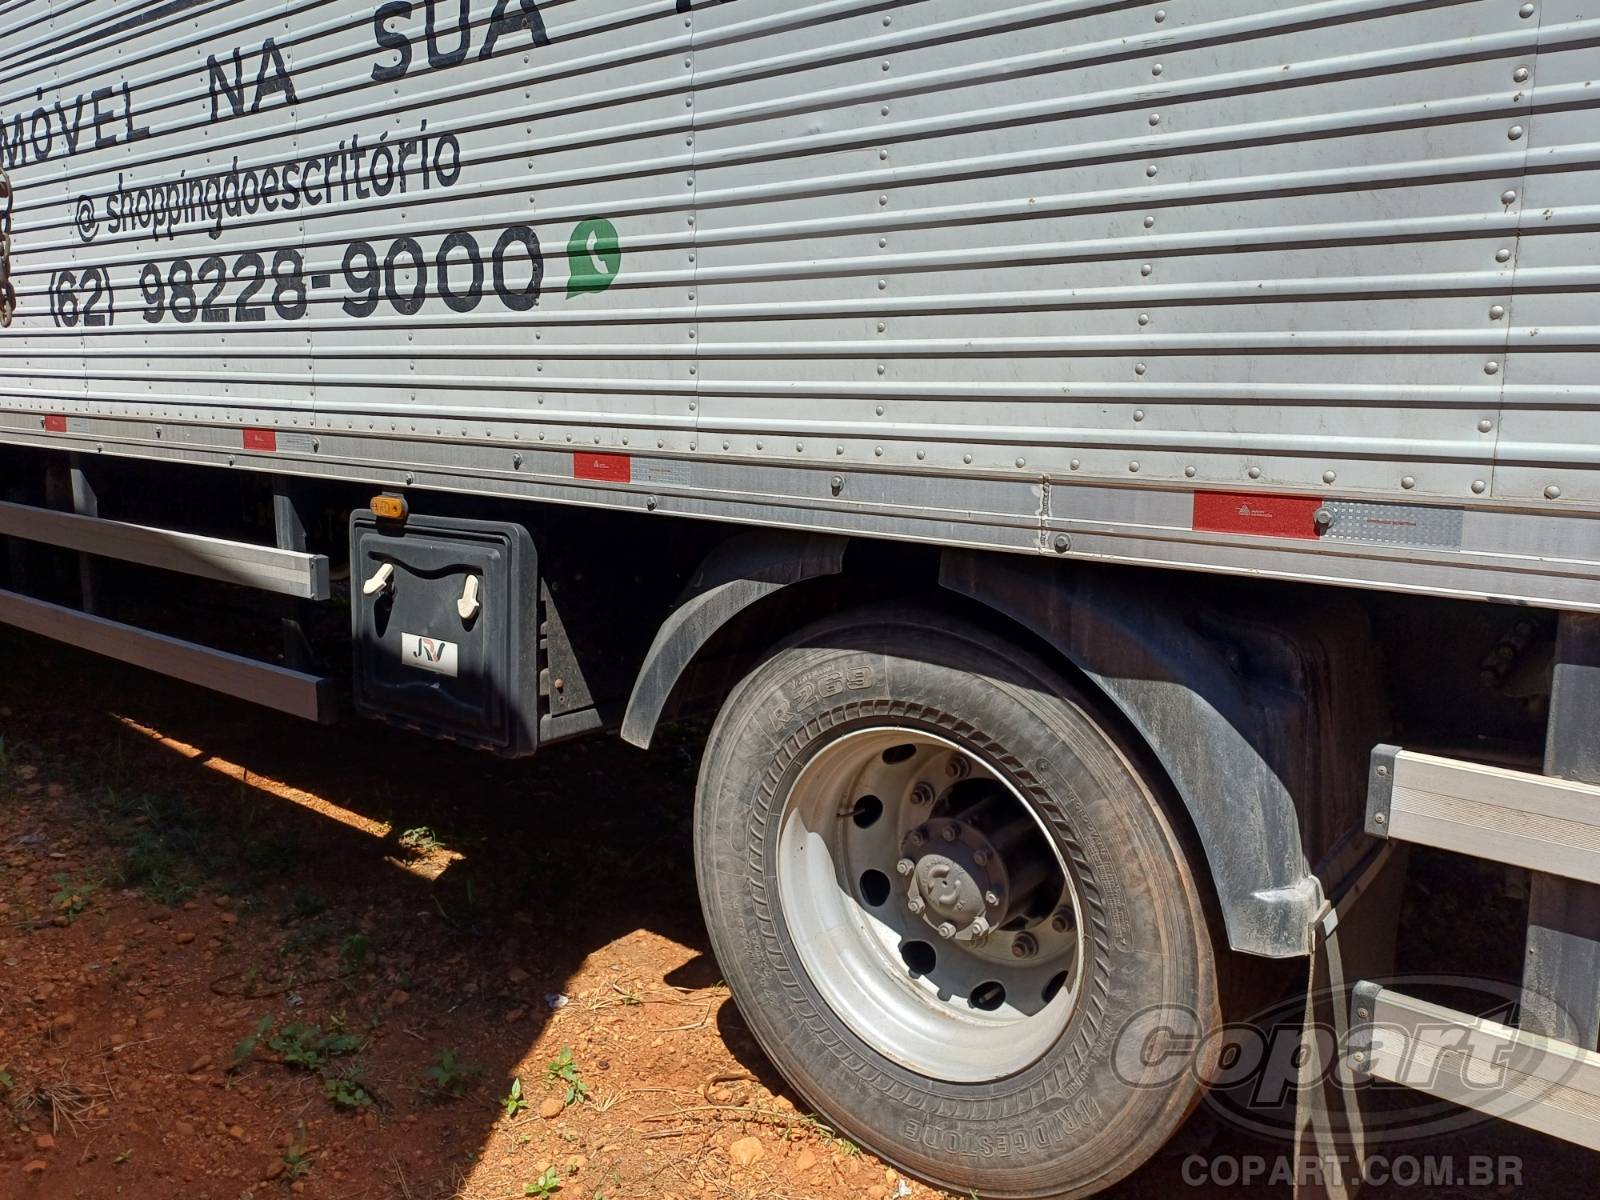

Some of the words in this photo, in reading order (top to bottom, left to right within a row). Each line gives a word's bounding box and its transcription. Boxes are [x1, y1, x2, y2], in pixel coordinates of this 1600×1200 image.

[206, 37, 300, 123] NA
[370, 0, 551, 82] SUA
[105, 119, 462, 241] shoppingdoescritório
[49, 265, 115, 328] (62)
[138, 225, 545, 324] 98228-9000
